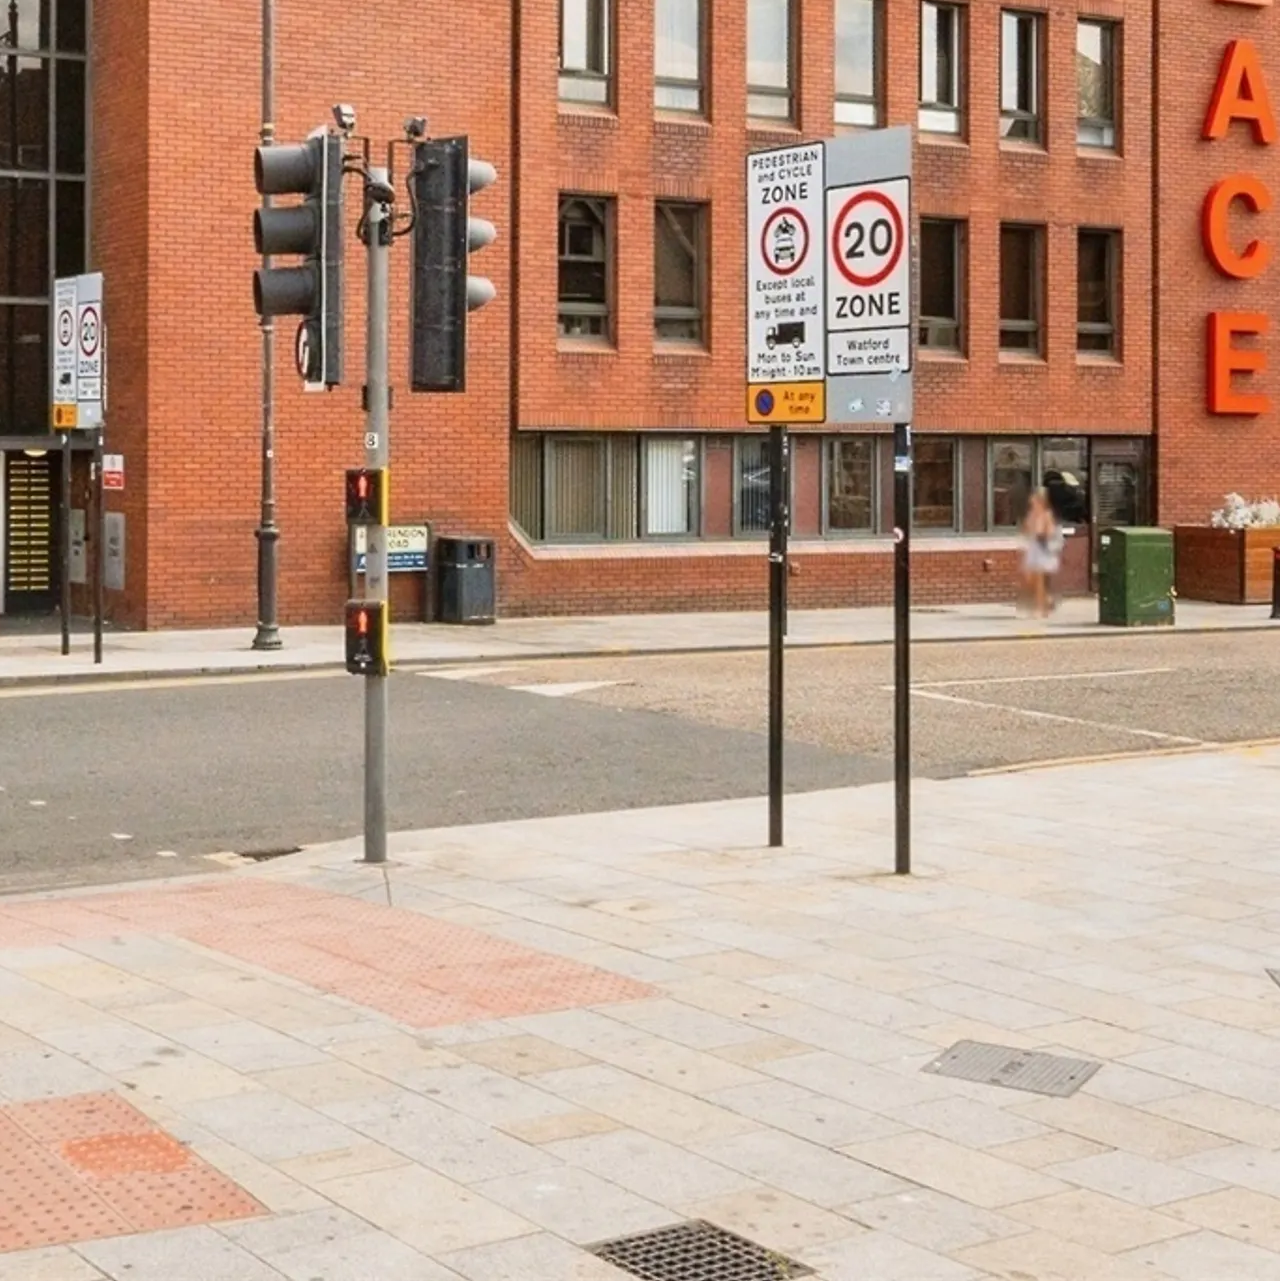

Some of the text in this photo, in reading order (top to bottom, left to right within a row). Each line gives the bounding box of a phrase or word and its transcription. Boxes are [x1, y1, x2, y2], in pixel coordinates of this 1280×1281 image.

[752, 150, 818, 170] PEDESTRIAN
[758, 163, 813, 183] and CYCLE
[761, 181, 809, 205] ZONE
[844, 218, 893, 259] 20
[756, 276, 816, 293] Except local
[764, 291, 806, 304] buses at
[754, 305, 818, 320] any time and
[835, 292, 901, 319] ZONE
[846, 337, 890, 352] Watford
[757, 351, 816, 364] Mon to Sun
[836, 353, 901, 366] Town centre
[782, 391, 816, 403] At any
[788, 405, 810, 416] time
